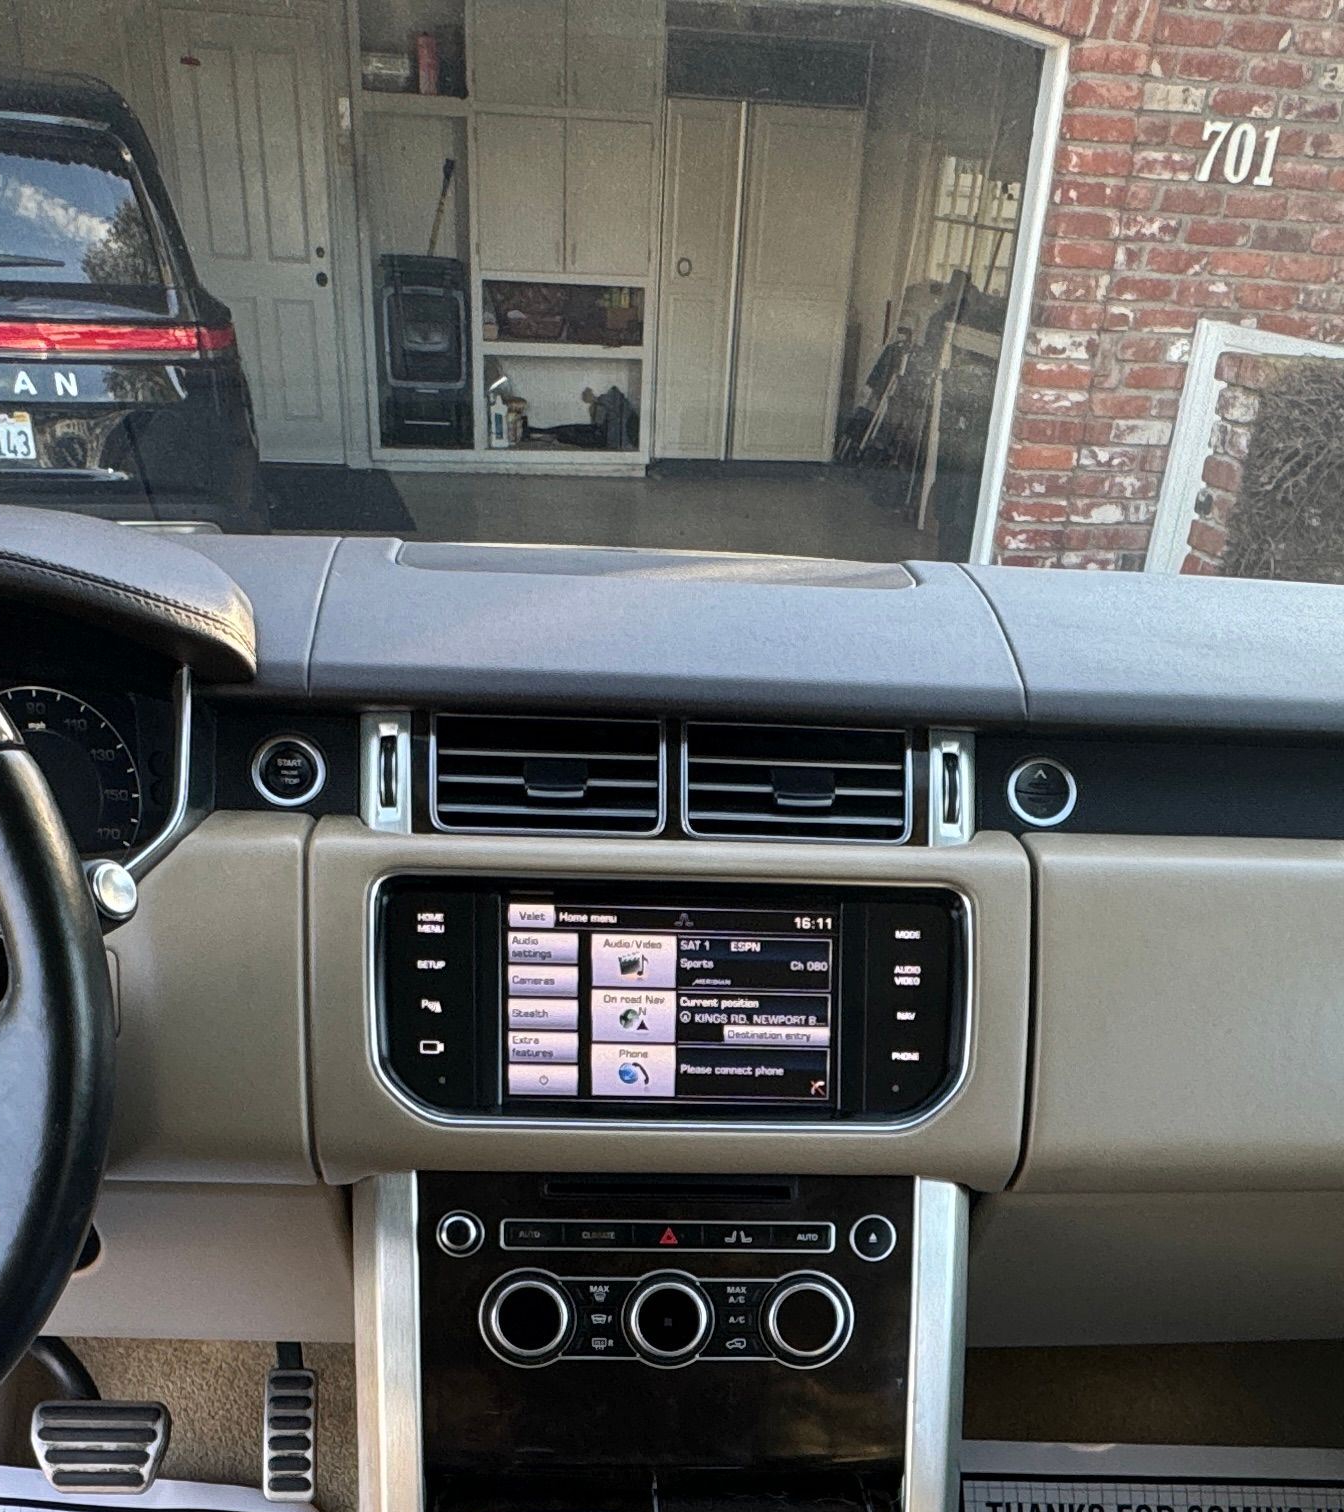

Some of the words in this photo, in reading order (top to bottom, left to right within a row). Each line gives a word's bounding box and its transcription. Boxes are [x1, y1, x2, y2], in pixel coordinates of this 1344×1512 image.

[1194, 120, 1281, 187] 701
[277, 758, 302, 767] START
[417, 913, 444, 922] HOME
[519, 911, 546, 921] Valet
[559, 912, 588, 923] Home
[590, 915, 617, 924] menu
[417, 924, 445, 933] MENU
[794, 917, 833, 930] 16:11
[895, 930, 921, 939] MODE
[512, 936, 539, 946] Audio
[603, 939, 662, 950] Audio/Video
[680, 941, 701, 951] SAT
[704, 941, 710, 951] 1
[730, 941, 761, 952] ESPN
[512, 950, 552, 961] settings
[417, 960, 446, 969] SETUP
[680, 959, 714, 971] Sports
[790, 961, 804, 972] Ch
[894, 965, 921, 974] AUDIO
[512, 975, 555, 986] Cameras
[894, 976, 921, 986] VIDEO
[603, 994, 617, 1004] On
[620, 994, 642, 1004] road
[646, 995, 665, 1004] Nav
[680, 997, 719, 1008] Current
[721, 998, 759, 1010] position
[512, 1008, 549, 1018] Stealth
[694, 1013, 728, 1024] KINGS
[753, 1015, 806, 1025] NEWPORT
[512, 1035, 540, 1045] Extra
[727, 1029, 783, 1040] Destination
[785, 1032, 812, 1042] entry
[512, 1047, 554, 1059] features
[619, 1048, 649, 1059] Phone
[892, 1051, 920, 1061] PHONE
[680, 1064, 712, 1075] Please
[714, 1065, 753, 1076] connect
[755, 1066, 785, 1078] phone
[797, 1233, 818, 1241] AUTO
[589, 1285, 610, 1293] MAX
[727, 1286, 747, 1294] MAX
[728, 1296, 746, 1304] A/C
[728, 1316, 746, 1324] A/C
